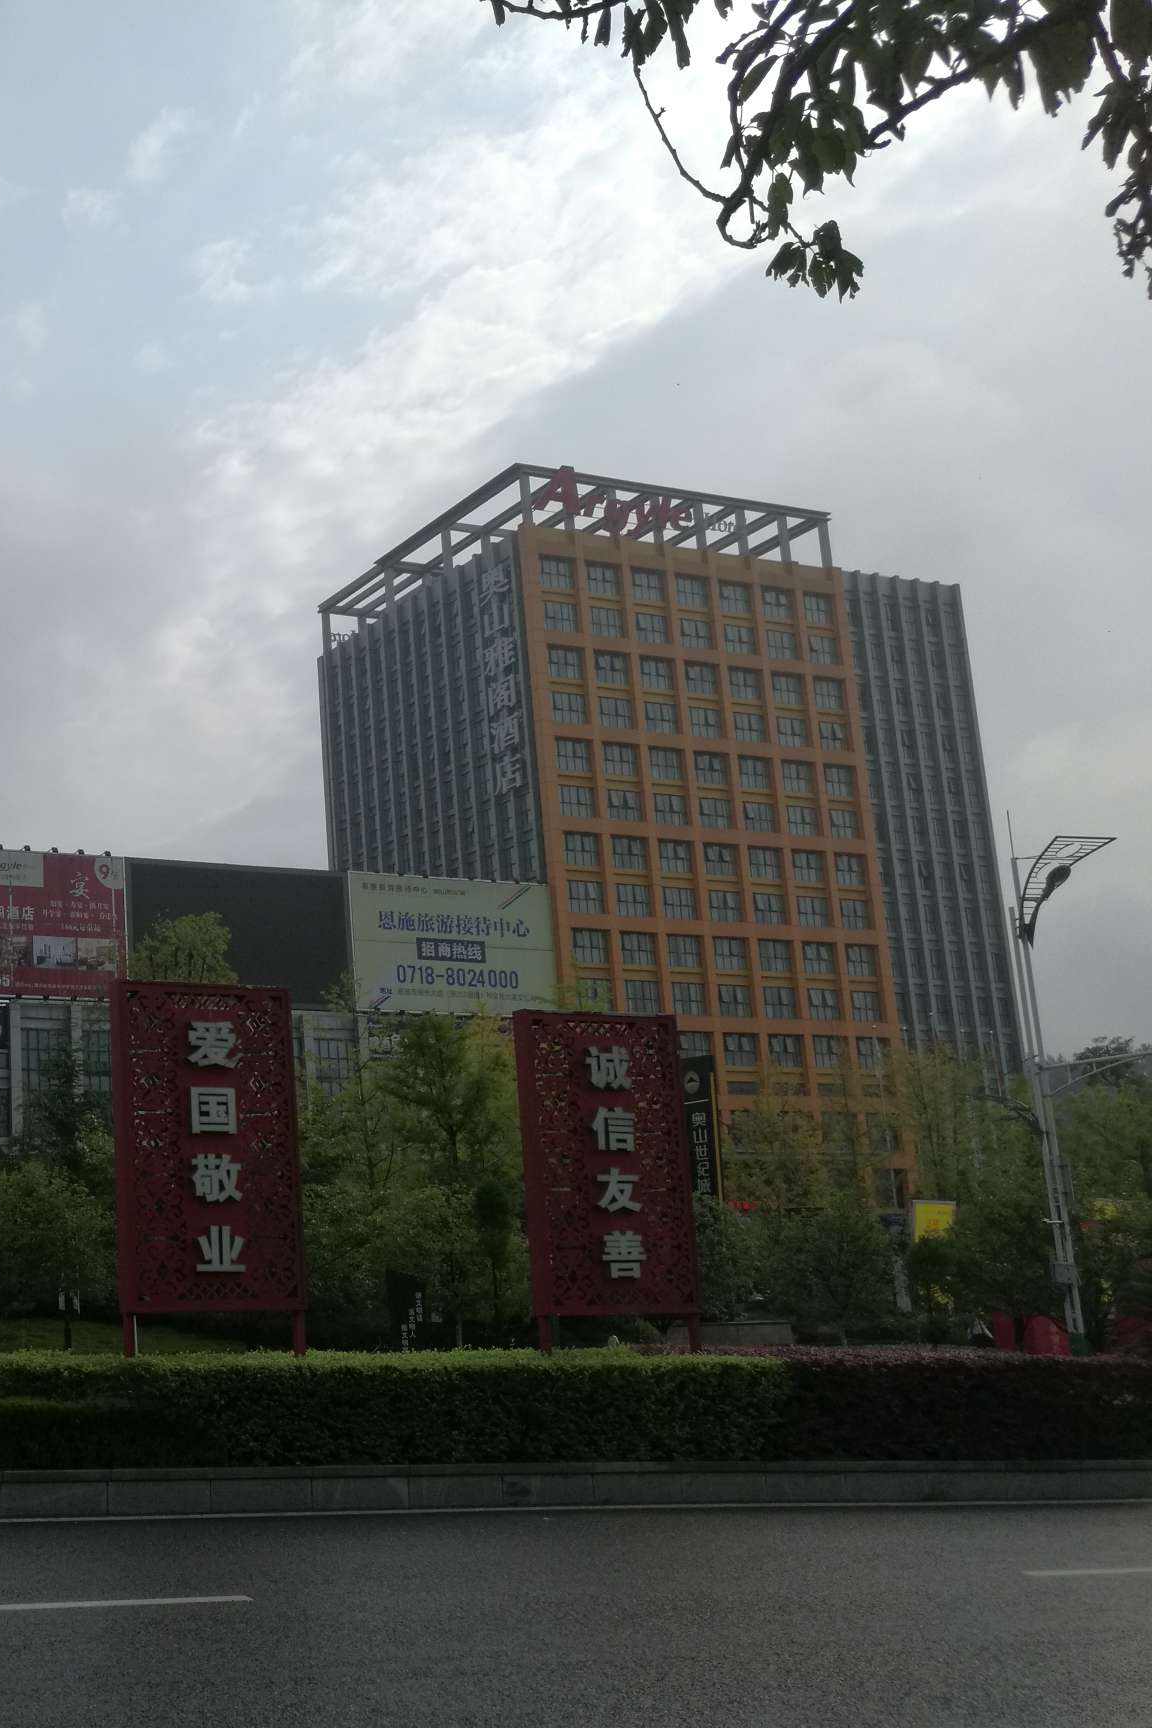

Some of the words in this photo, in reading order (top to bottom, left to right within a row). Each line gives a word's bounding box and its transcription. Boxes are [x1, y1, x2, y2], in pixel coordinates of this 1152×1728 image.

[531, 465, 694, 538] Argyle
[480, 565, 524, 796] 奥山雅阁酒店
[378, 911, 530, 938] 恩施旅游接待中心
[421, 941, 483, 961] 招商热线
[396, 964, 519, 990] 0718-8024000
[187, 1020, 247, 1273] 爱国敬业
[585, 1045, 648, 1280] 诚信友善
[691, 1112, 711, 1193] 奥山世纪城
